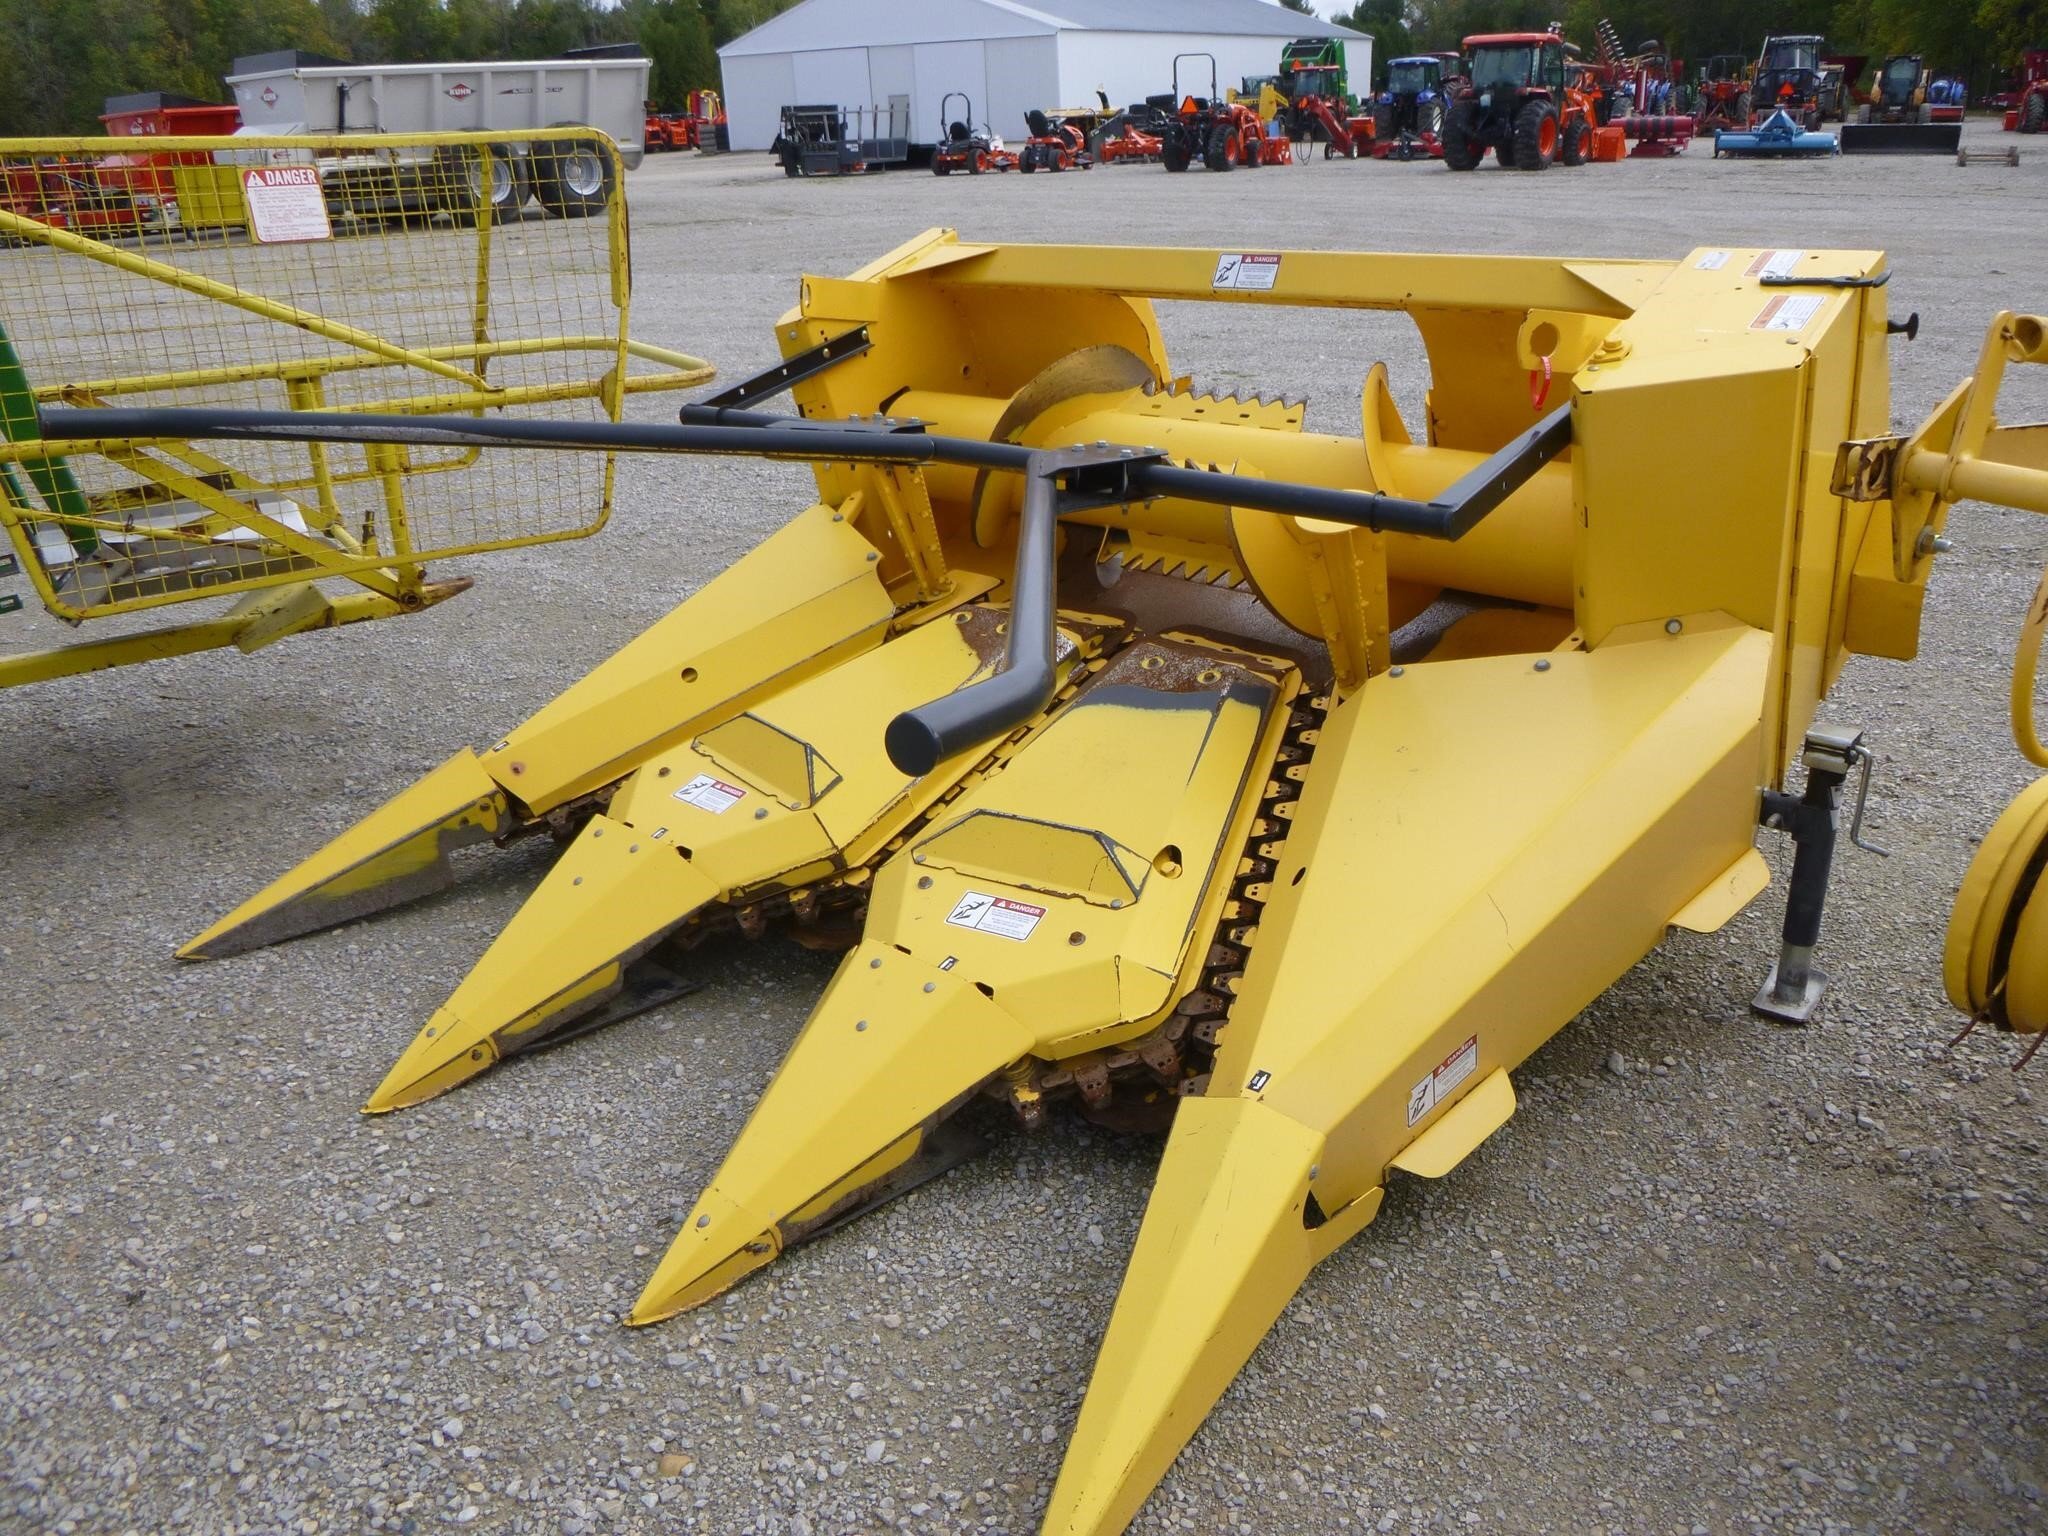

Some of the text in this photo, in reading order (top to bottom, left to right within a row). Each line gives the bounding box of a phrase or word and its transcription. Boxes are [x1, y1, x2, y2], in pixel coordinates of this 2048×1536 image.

[264, 169, 317, 186] DANGER
[1008, 903, 1041, 915] DANGER
[1447, 1039, 1474, 1065] DANGER
